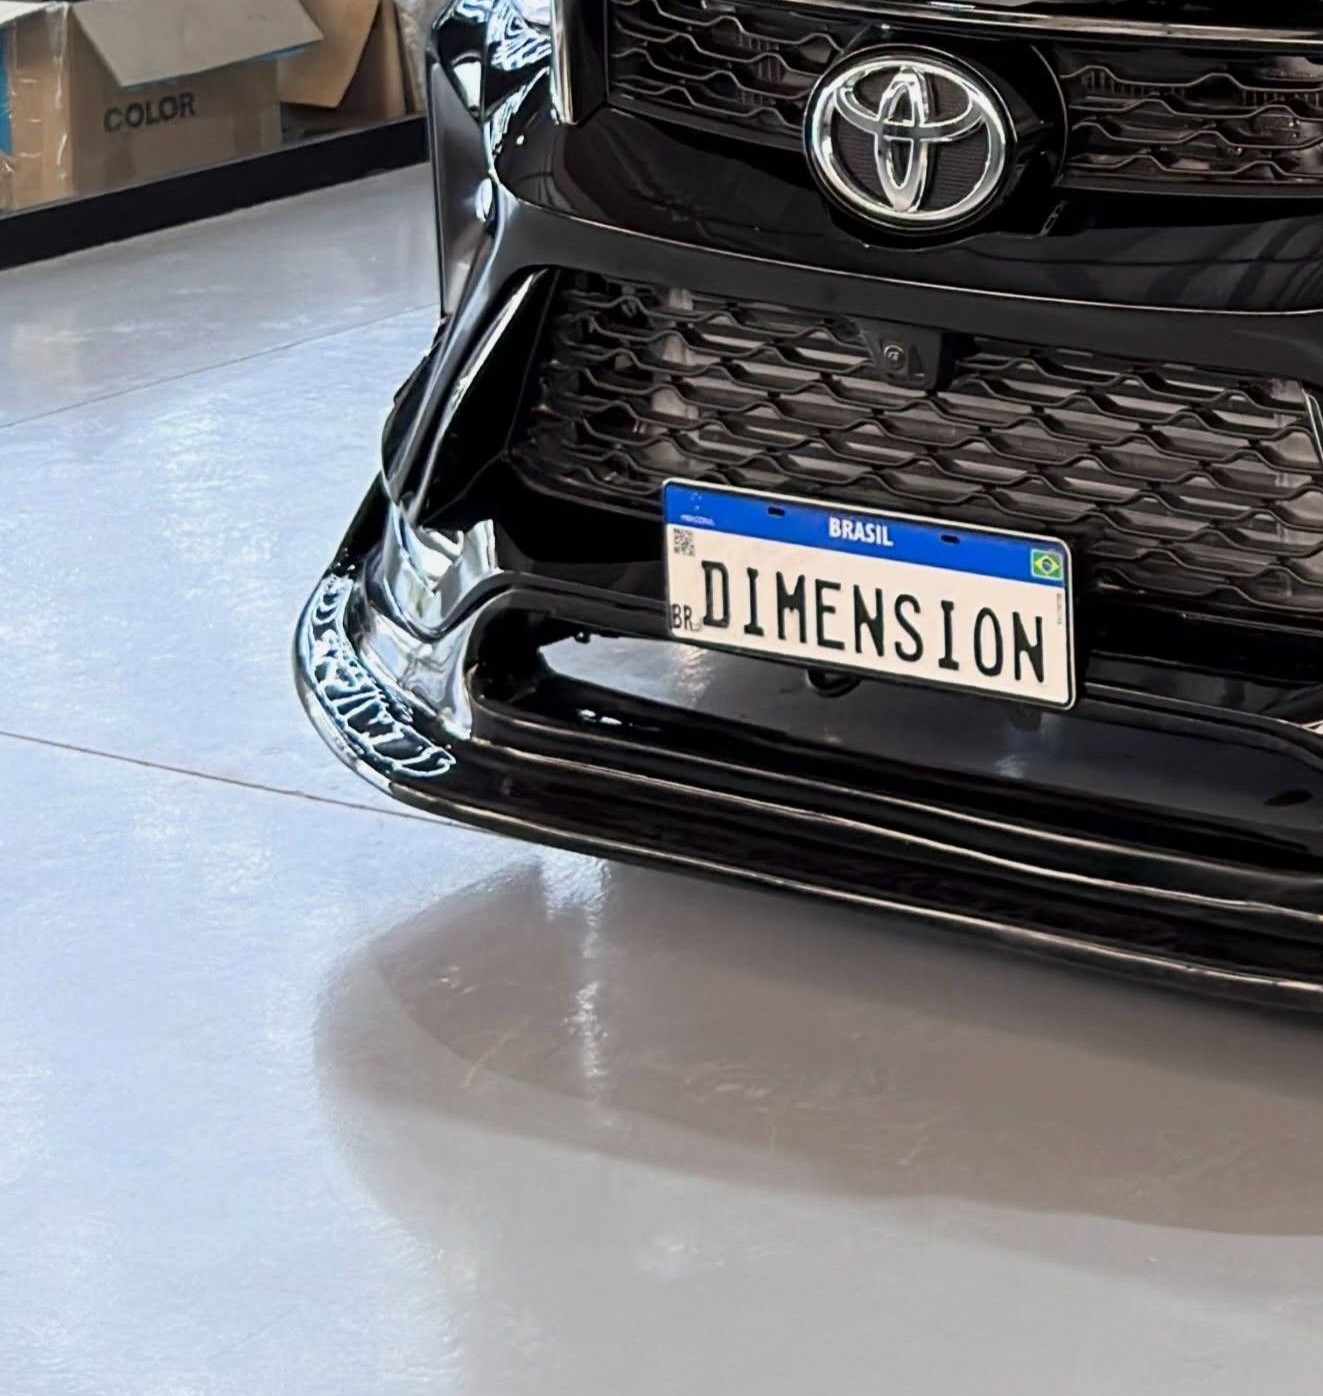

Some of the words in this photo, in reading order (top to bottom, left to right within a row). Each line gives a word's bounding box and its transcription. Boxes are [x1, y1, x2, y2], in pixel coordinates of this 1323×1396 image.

[103, 92, 197, 134] COLOR
[828, 516, 894, 548] BRASIL
[671, 603, 694, 631] BR
[700, 559, 1045, 683] DIMENSION
